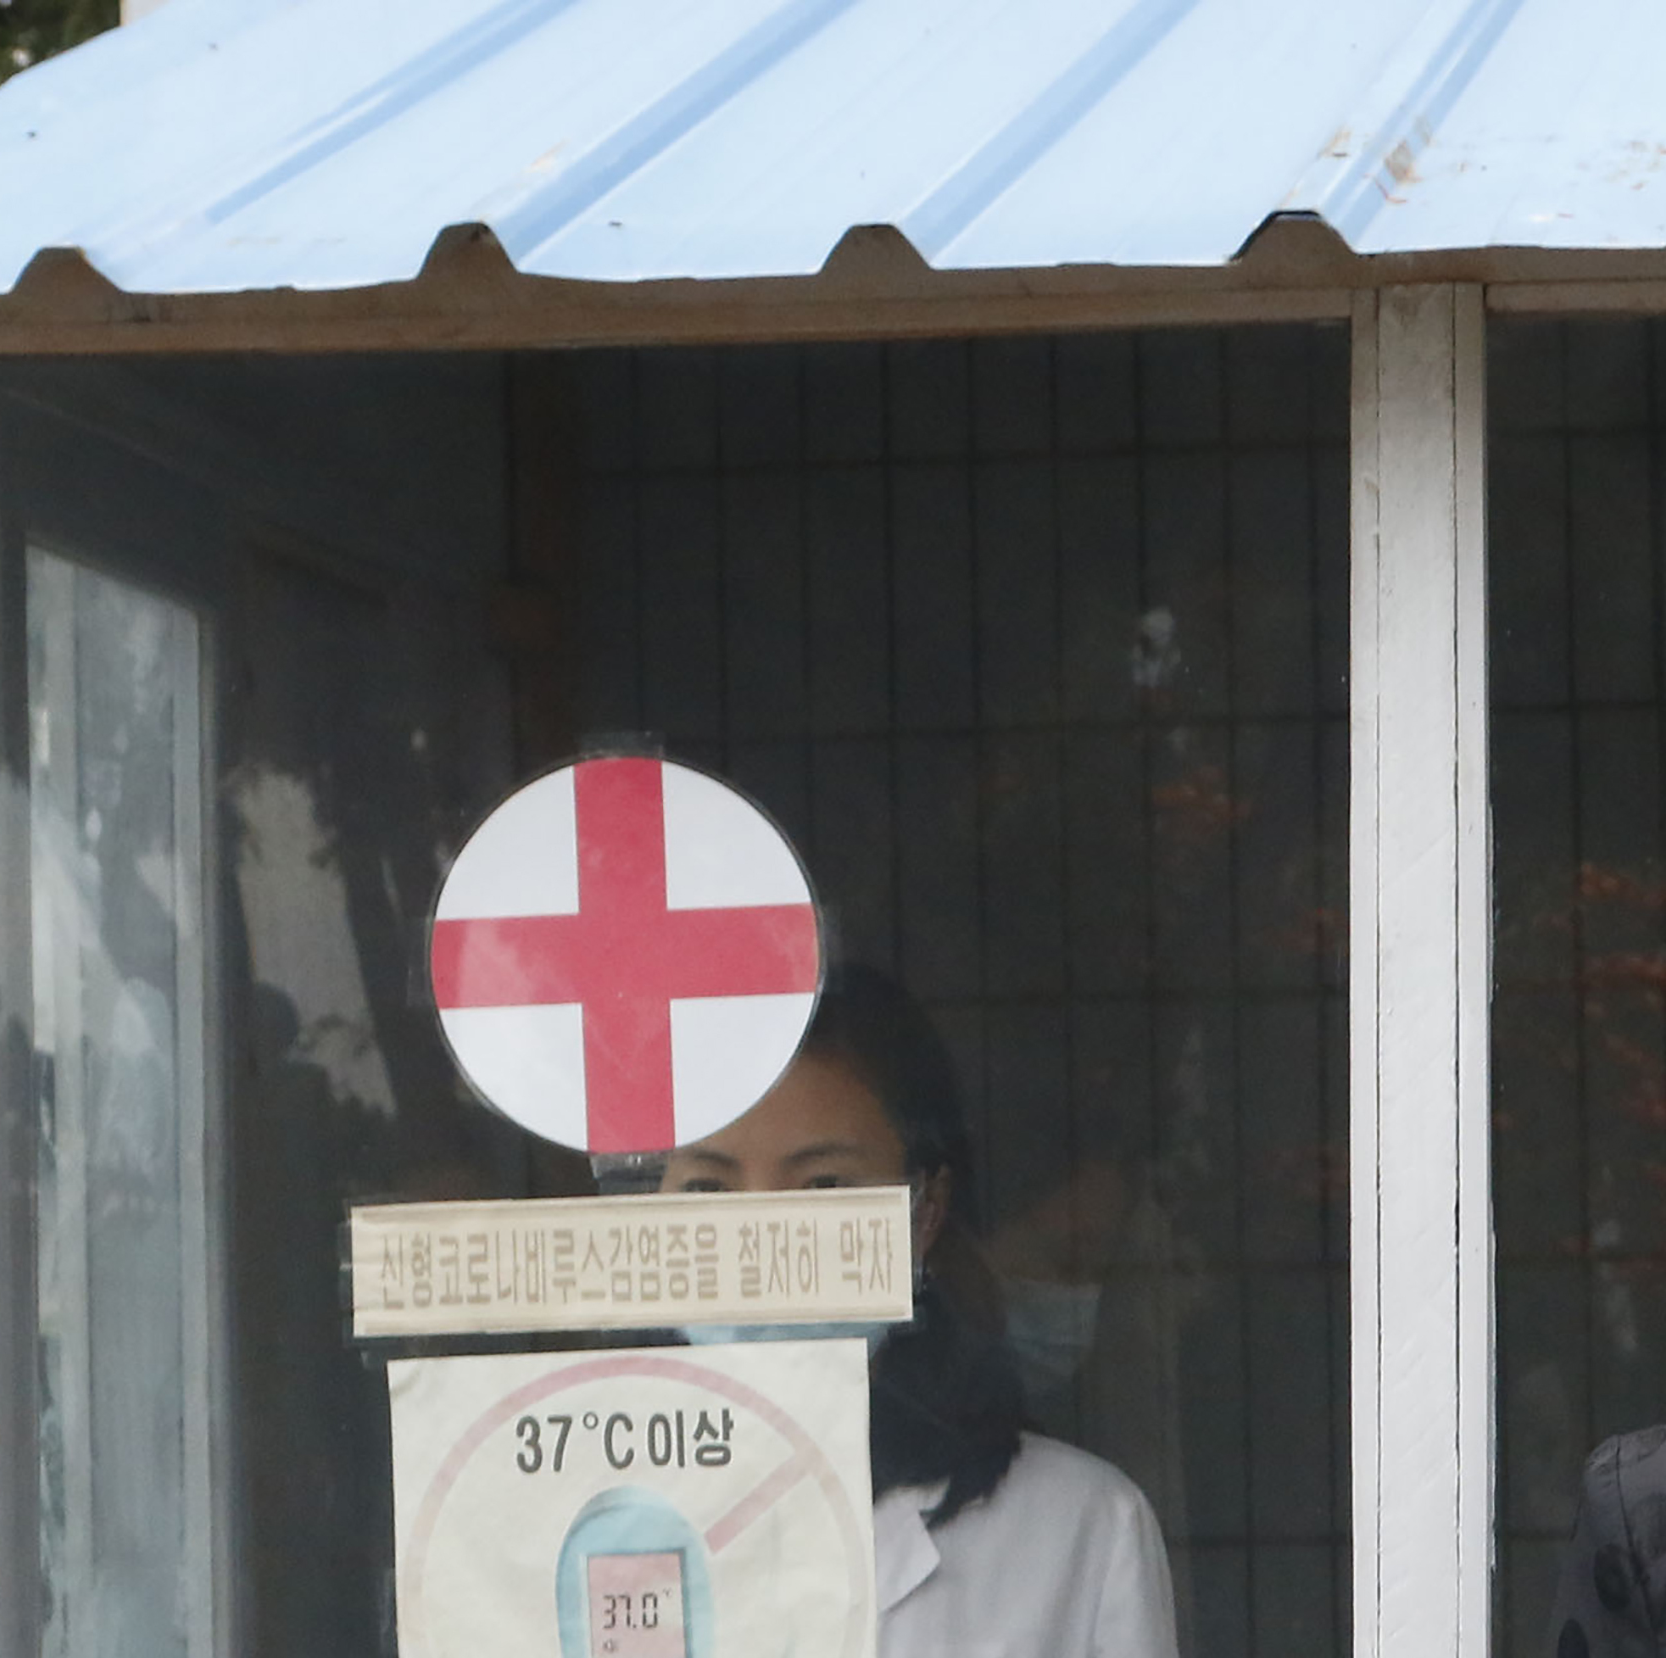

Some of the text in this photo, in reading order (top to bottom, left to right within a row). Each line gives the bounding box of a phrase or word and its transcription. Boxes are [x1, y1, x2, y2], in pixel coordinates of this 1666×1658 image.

[381, 1217, 894, 1310] 신형코로나비루스감염증을 철저히 막자
[602, 1591, 658, 1630] 37.0
